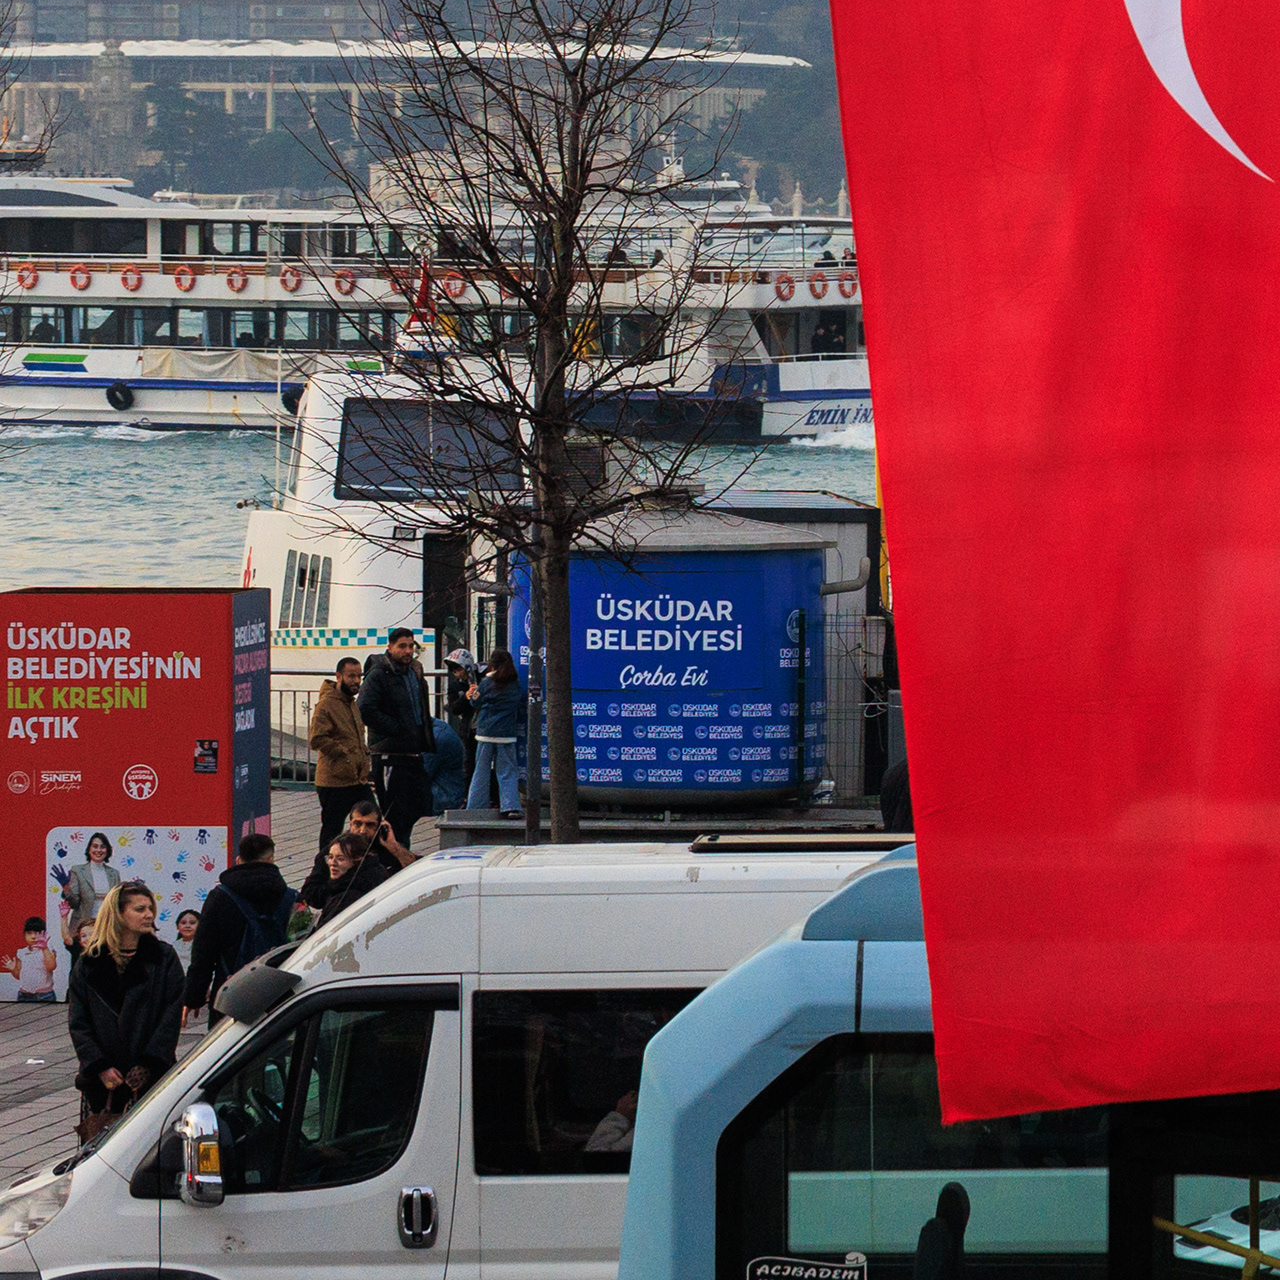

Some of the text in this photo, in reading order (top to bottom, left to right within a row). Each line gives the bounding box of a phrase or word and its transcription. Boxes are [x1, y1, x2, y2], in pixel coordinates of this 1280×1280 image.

[804, 404, 852, 426] EMİN
[597, 593, 733, 621] ÜSKÜDAR
[7, 622, 131, 650] ÜSKÜDAR
[586, 624, 742, 651] BELEDİYESİ
[7, 651, 201, 679] BELEDİYESİ'NİN
[619, 664, 709, 689] Çorba Evi
[7, 682, 147, 715] İLK KREŞİNİ
[7, 716, 79, 744] AÇTIK
[756, 1264, 860, 1280] ACIBADEM
